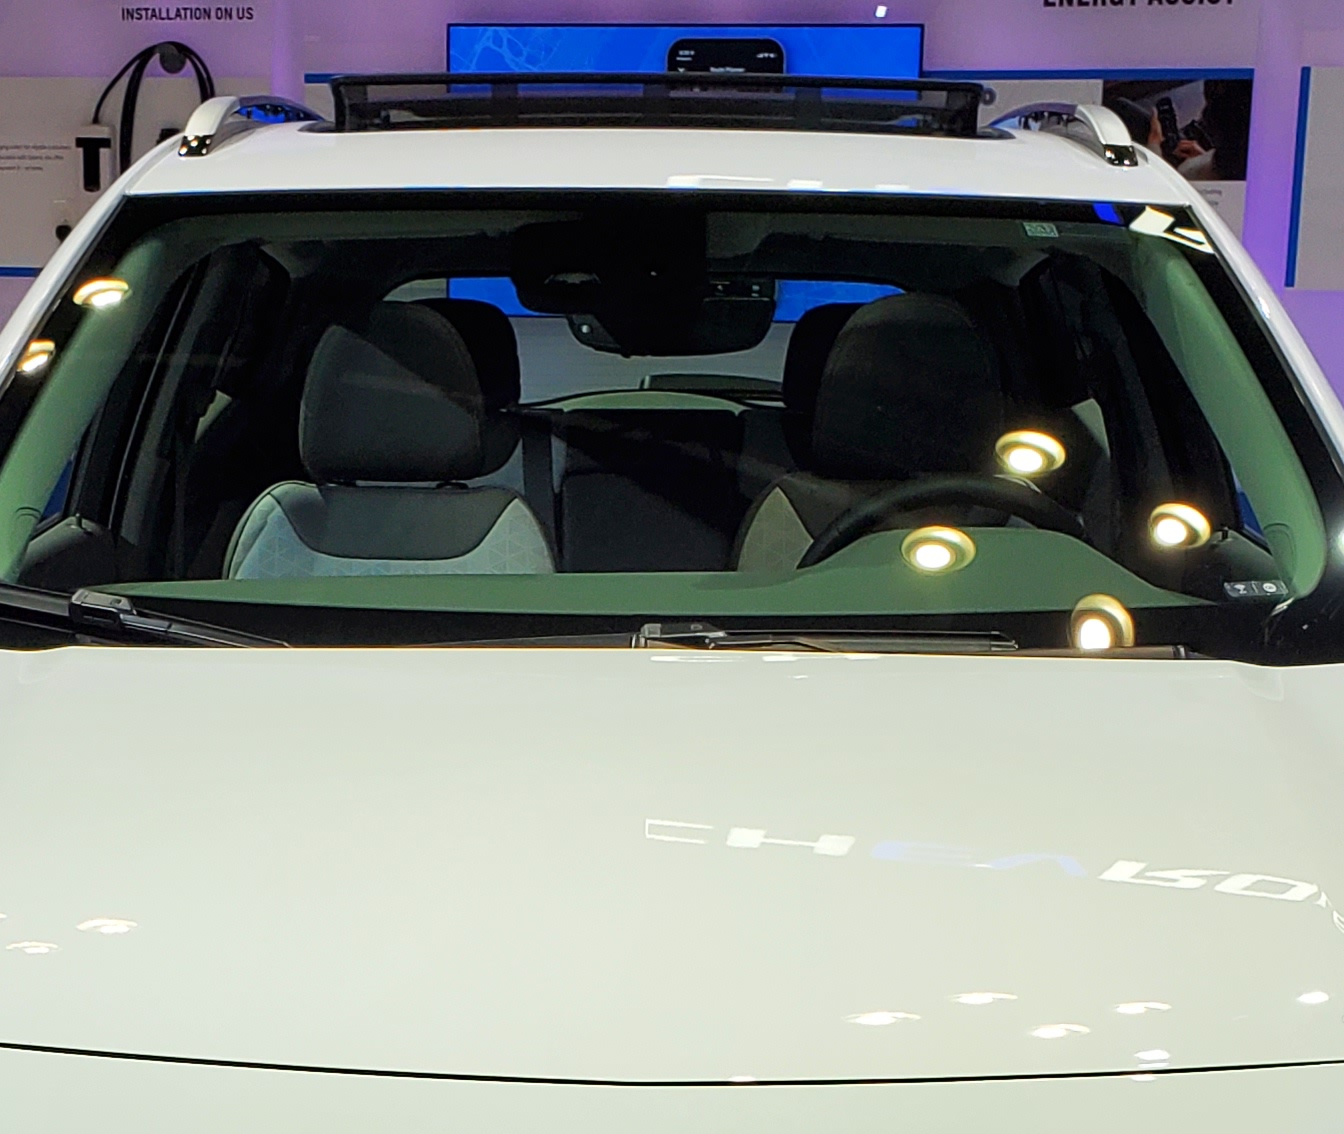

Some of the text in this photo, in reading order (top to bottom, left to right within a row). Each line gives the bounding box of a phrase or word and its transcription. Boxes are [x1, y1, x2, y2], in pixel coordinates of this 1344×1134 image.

[121, 7, 254, 21] INSTALLATION ON US
